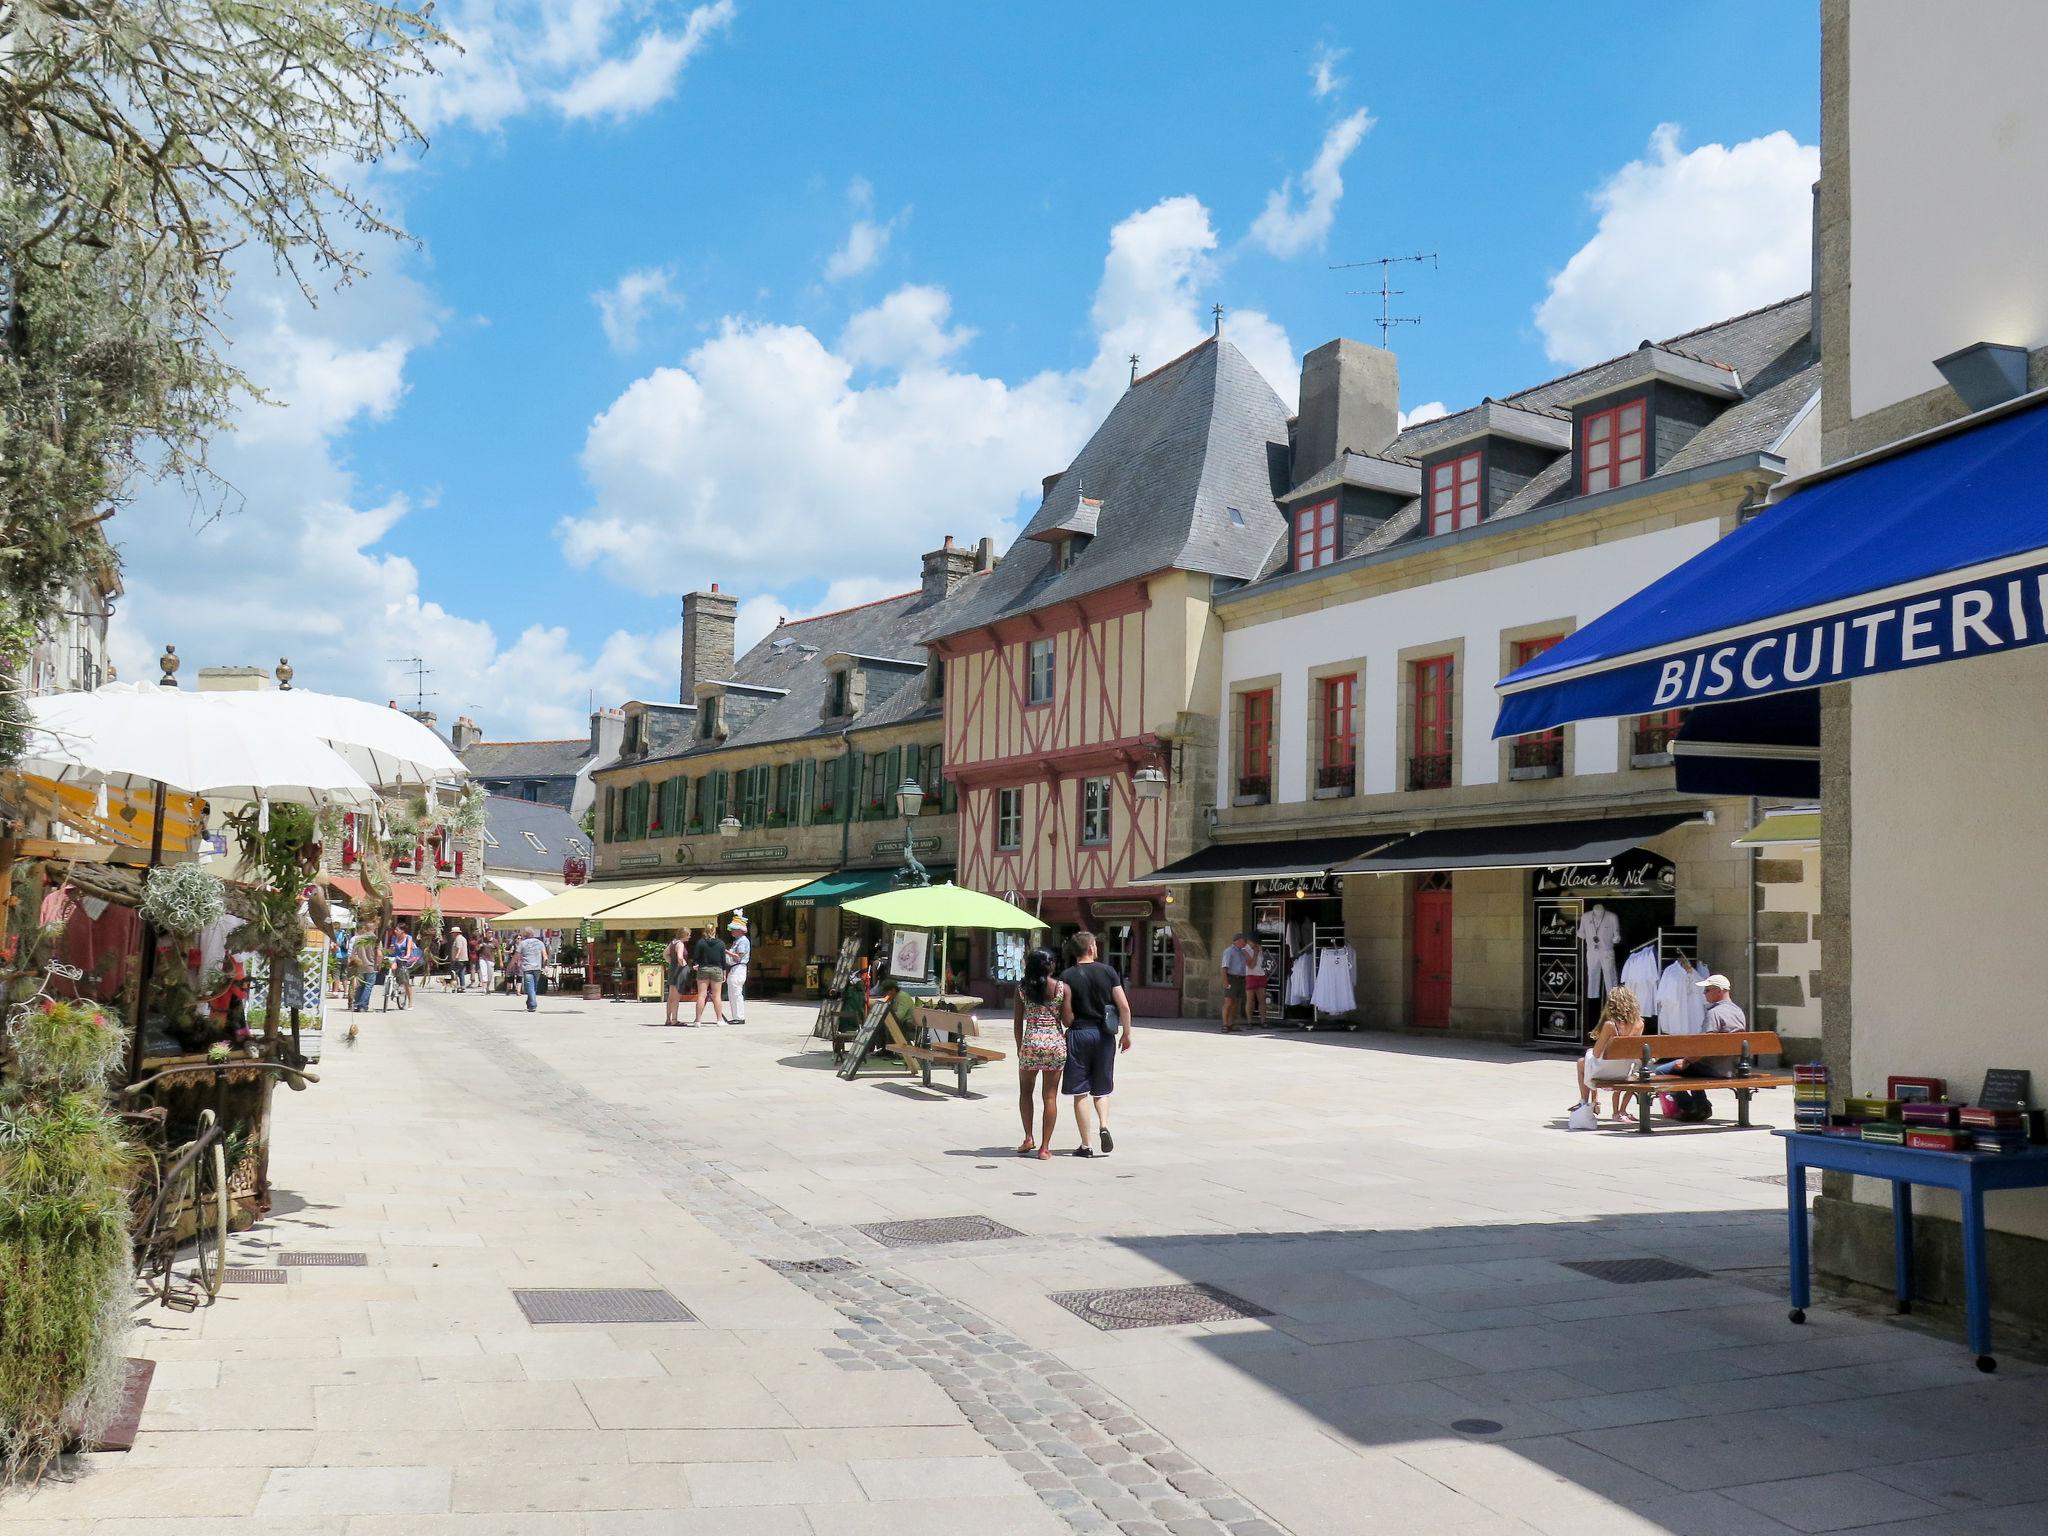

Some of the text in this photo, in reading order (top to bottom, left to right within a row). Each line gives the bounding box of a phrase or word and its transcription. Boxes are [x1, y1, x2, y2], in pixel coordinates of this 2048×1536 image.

[1601, 866, 1620, 886] du
[1623, 863, 1649, 887] Nil
[1548, 971, 1568, 986] 25€
